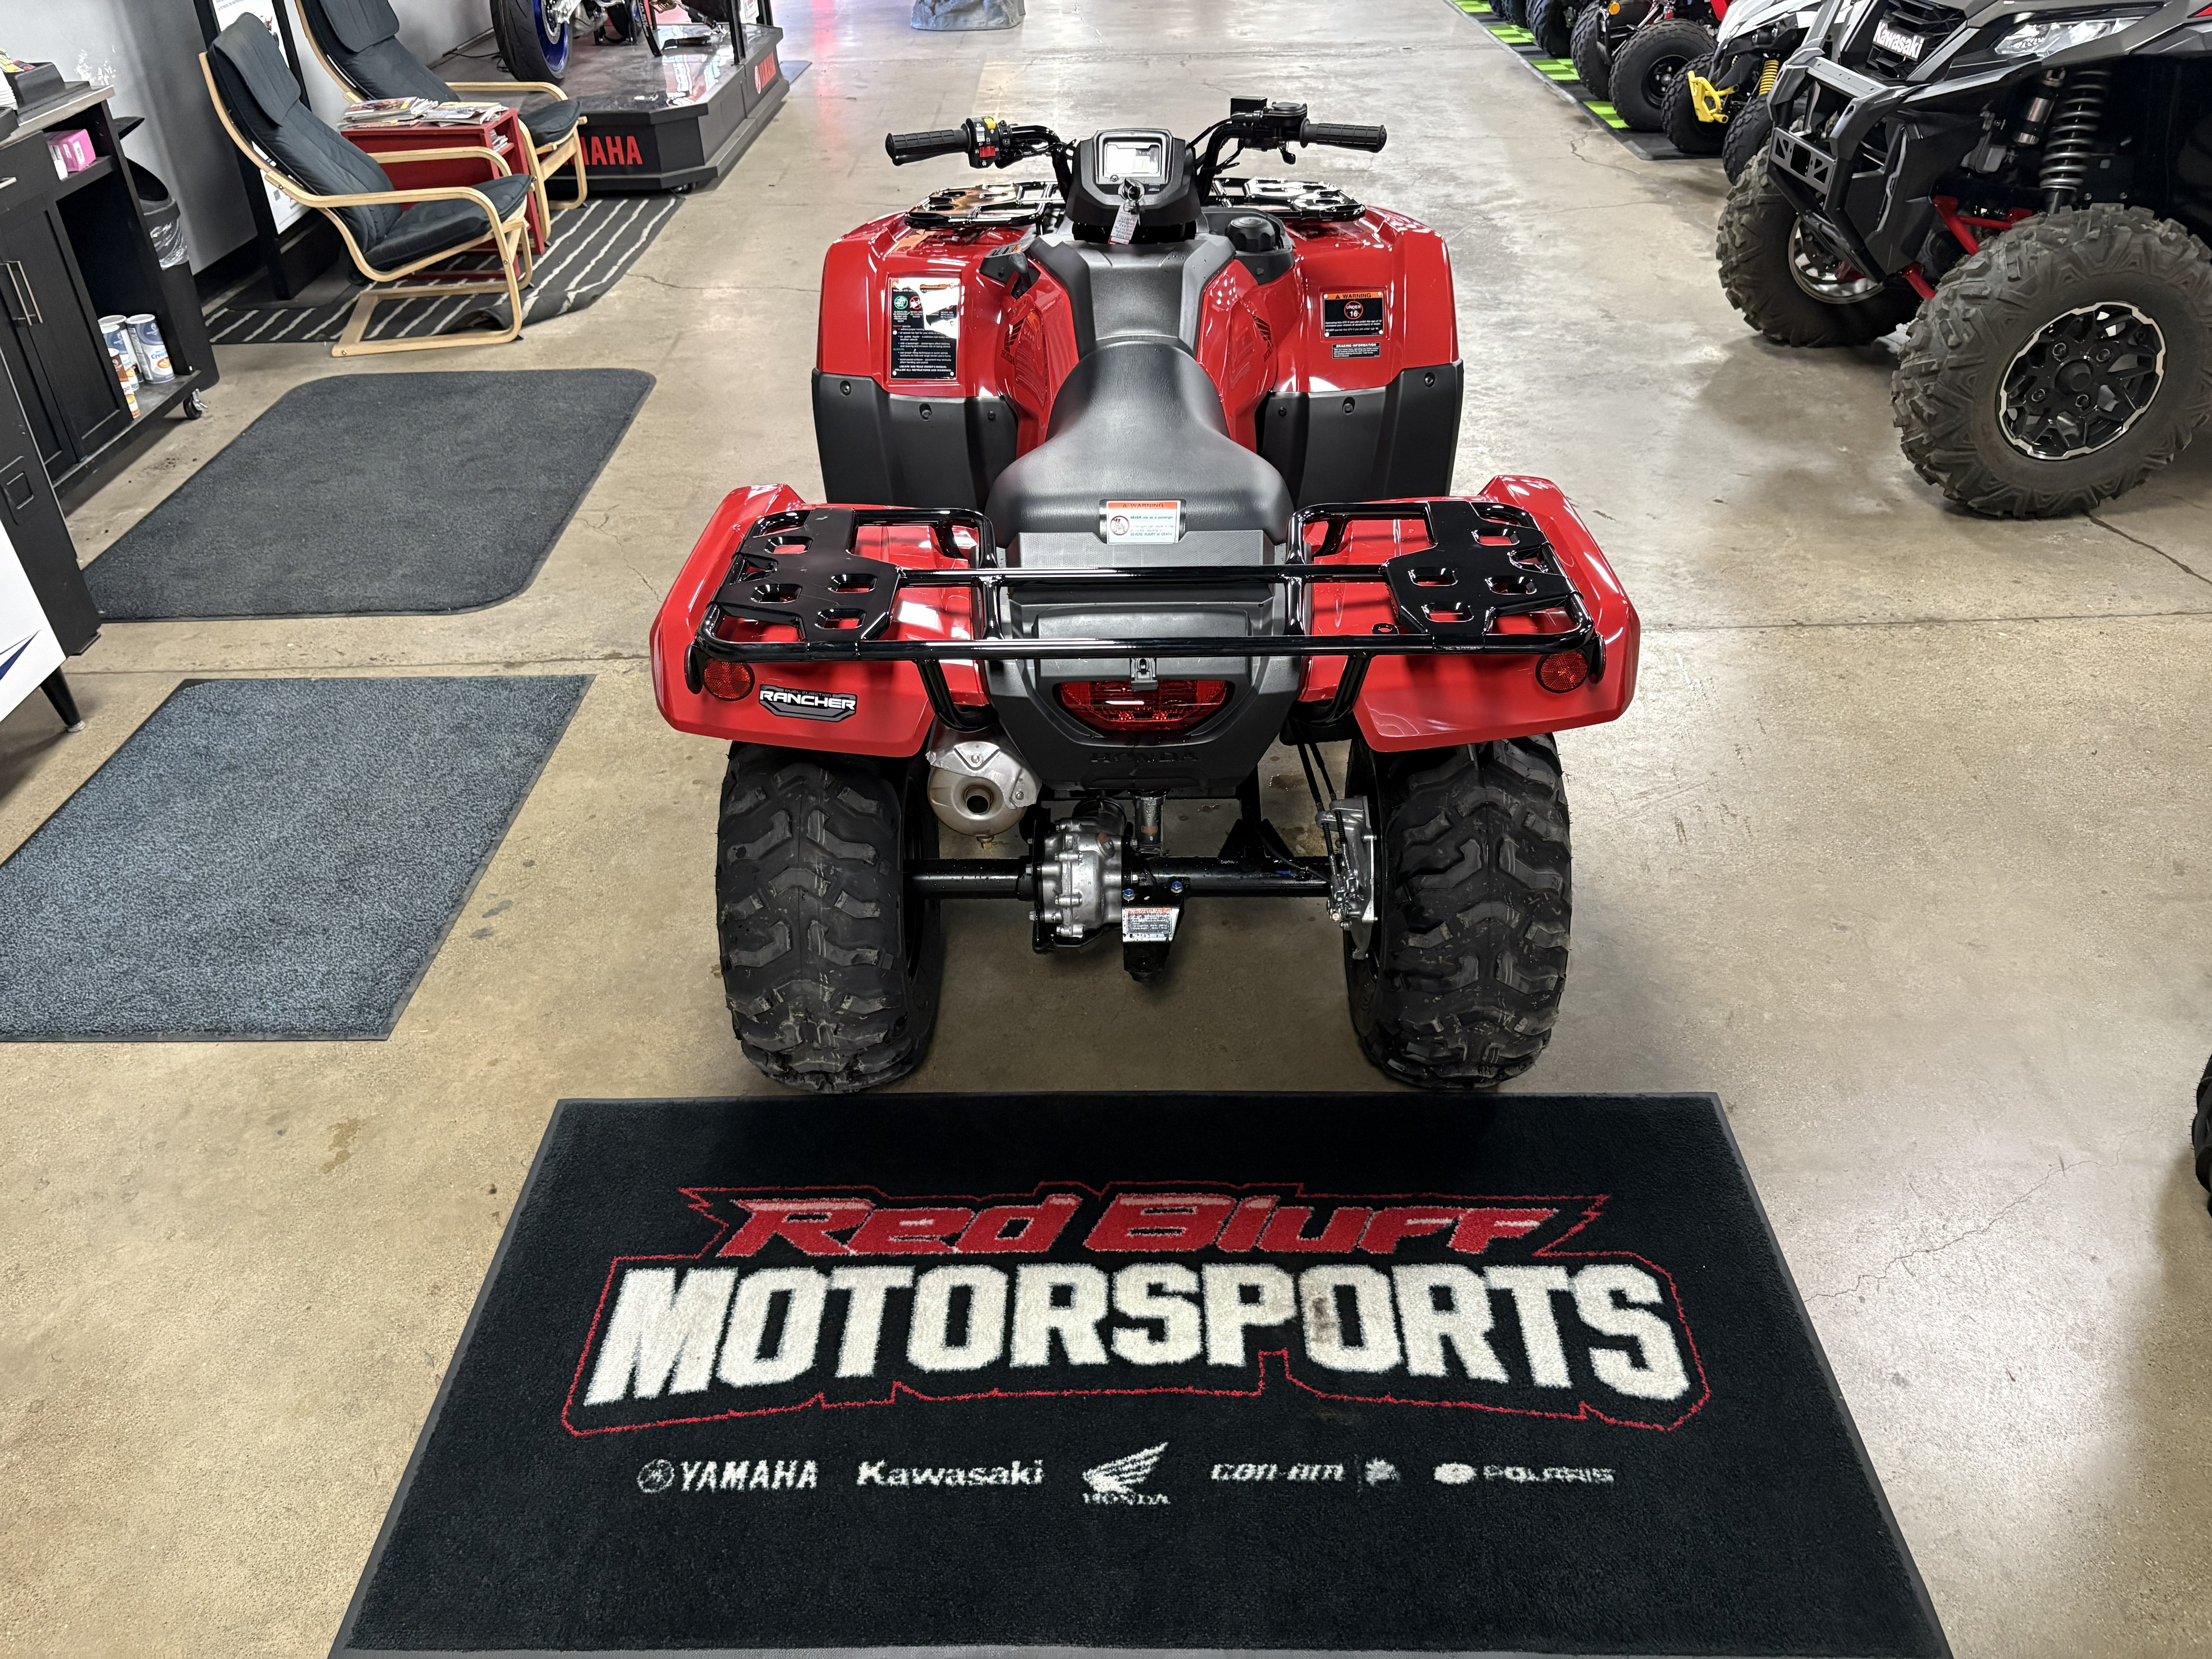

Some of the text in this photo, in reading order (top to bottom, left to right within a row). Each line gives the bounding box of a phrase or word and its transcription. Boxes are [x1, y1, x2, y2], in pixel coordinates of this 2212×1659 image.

[1873, 21, 1925, 58] Kawasaki
[760, 690, 856, 710] RANCHER
[1091, 752, 1200, 763] HONDA
[716, 1194, 1084, 1257] Red
[583, 1263, 1691, 1401] MOTORSPORTS
[680, 1459, 818, 1492] YAMAHA
[856, 1459, 1044, 1486] Kawasaki
